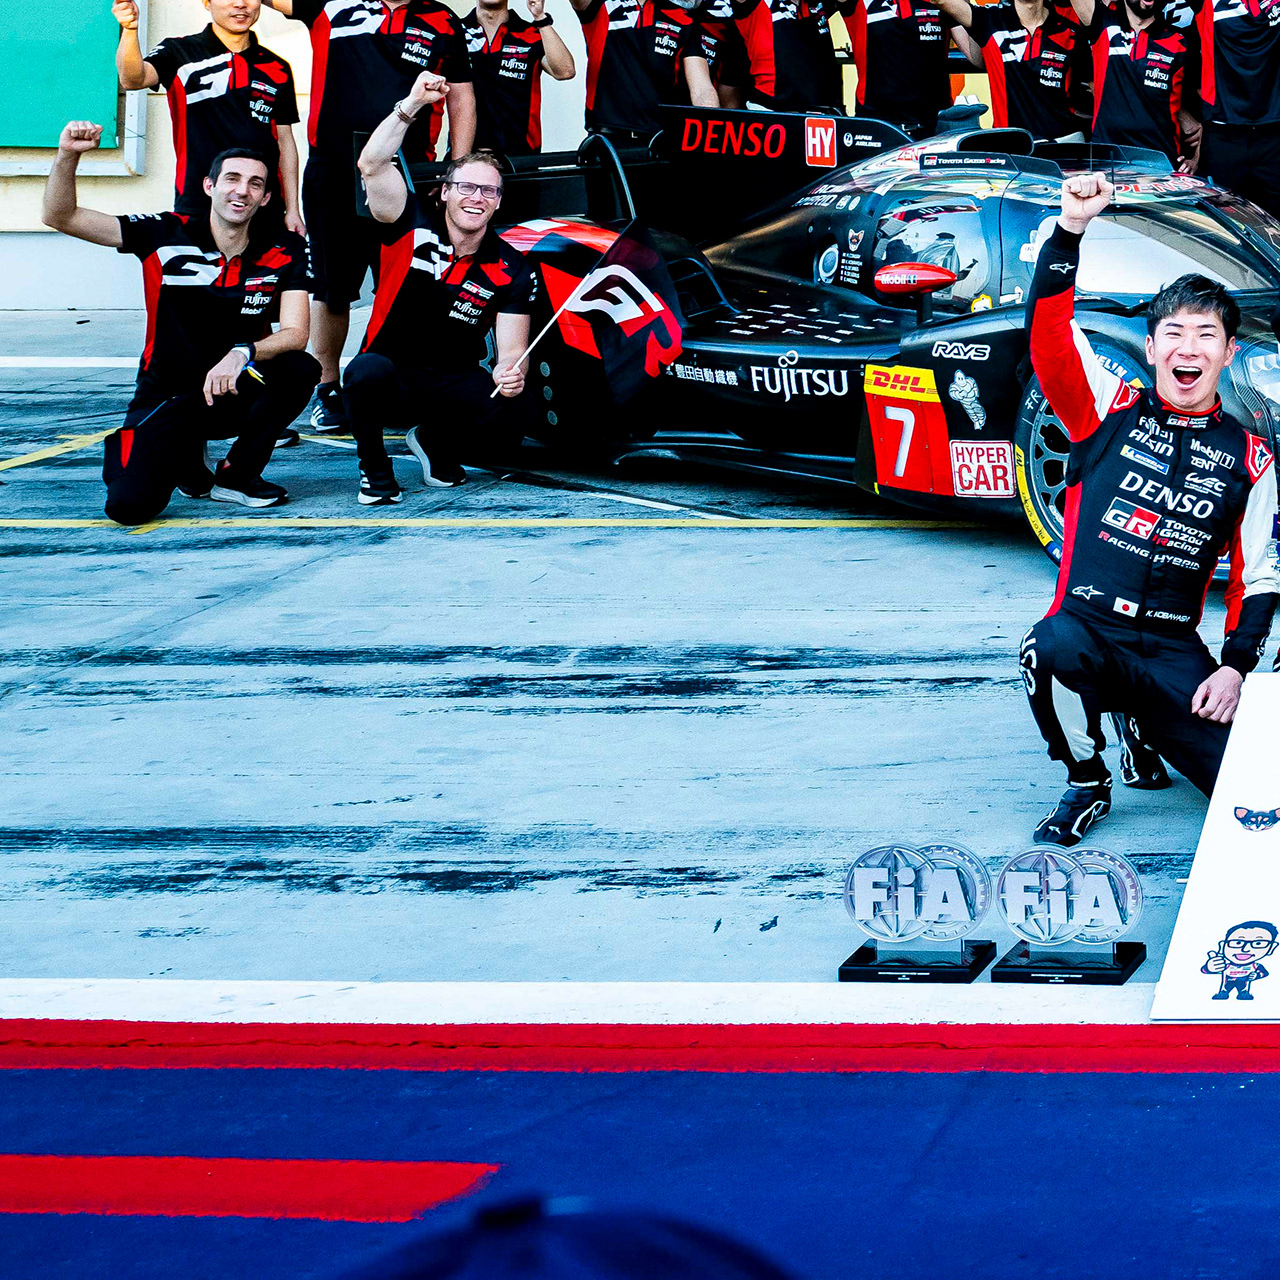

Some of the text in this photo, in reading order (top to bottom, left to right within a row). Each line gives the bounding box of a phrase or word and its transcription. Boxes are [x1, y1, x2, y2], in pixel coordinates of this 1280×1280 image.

[404, 42, 432, 58] FUJITSU
[502, 58, 528, 72] FUJITSU
[681, 119, 787, 159] DENSO
[807, 125, 834, 159] HY
[454, 301, 483, 317] FUJITSU
[932, 341, 990, 360] RAYS
[750, 351, 849, 402] FUJITSU
[872, 371, 929, 394] DHL
[884, 406, 916, 478] 7
[955, 446, 1008, 464] HYPER
[955, 464, 1010, 493] CAR
[1119, 471, 1214, 519] DENSO
[1103, 508, 1153, 538] GR
[1098, 531, 1150, 558] RACING
